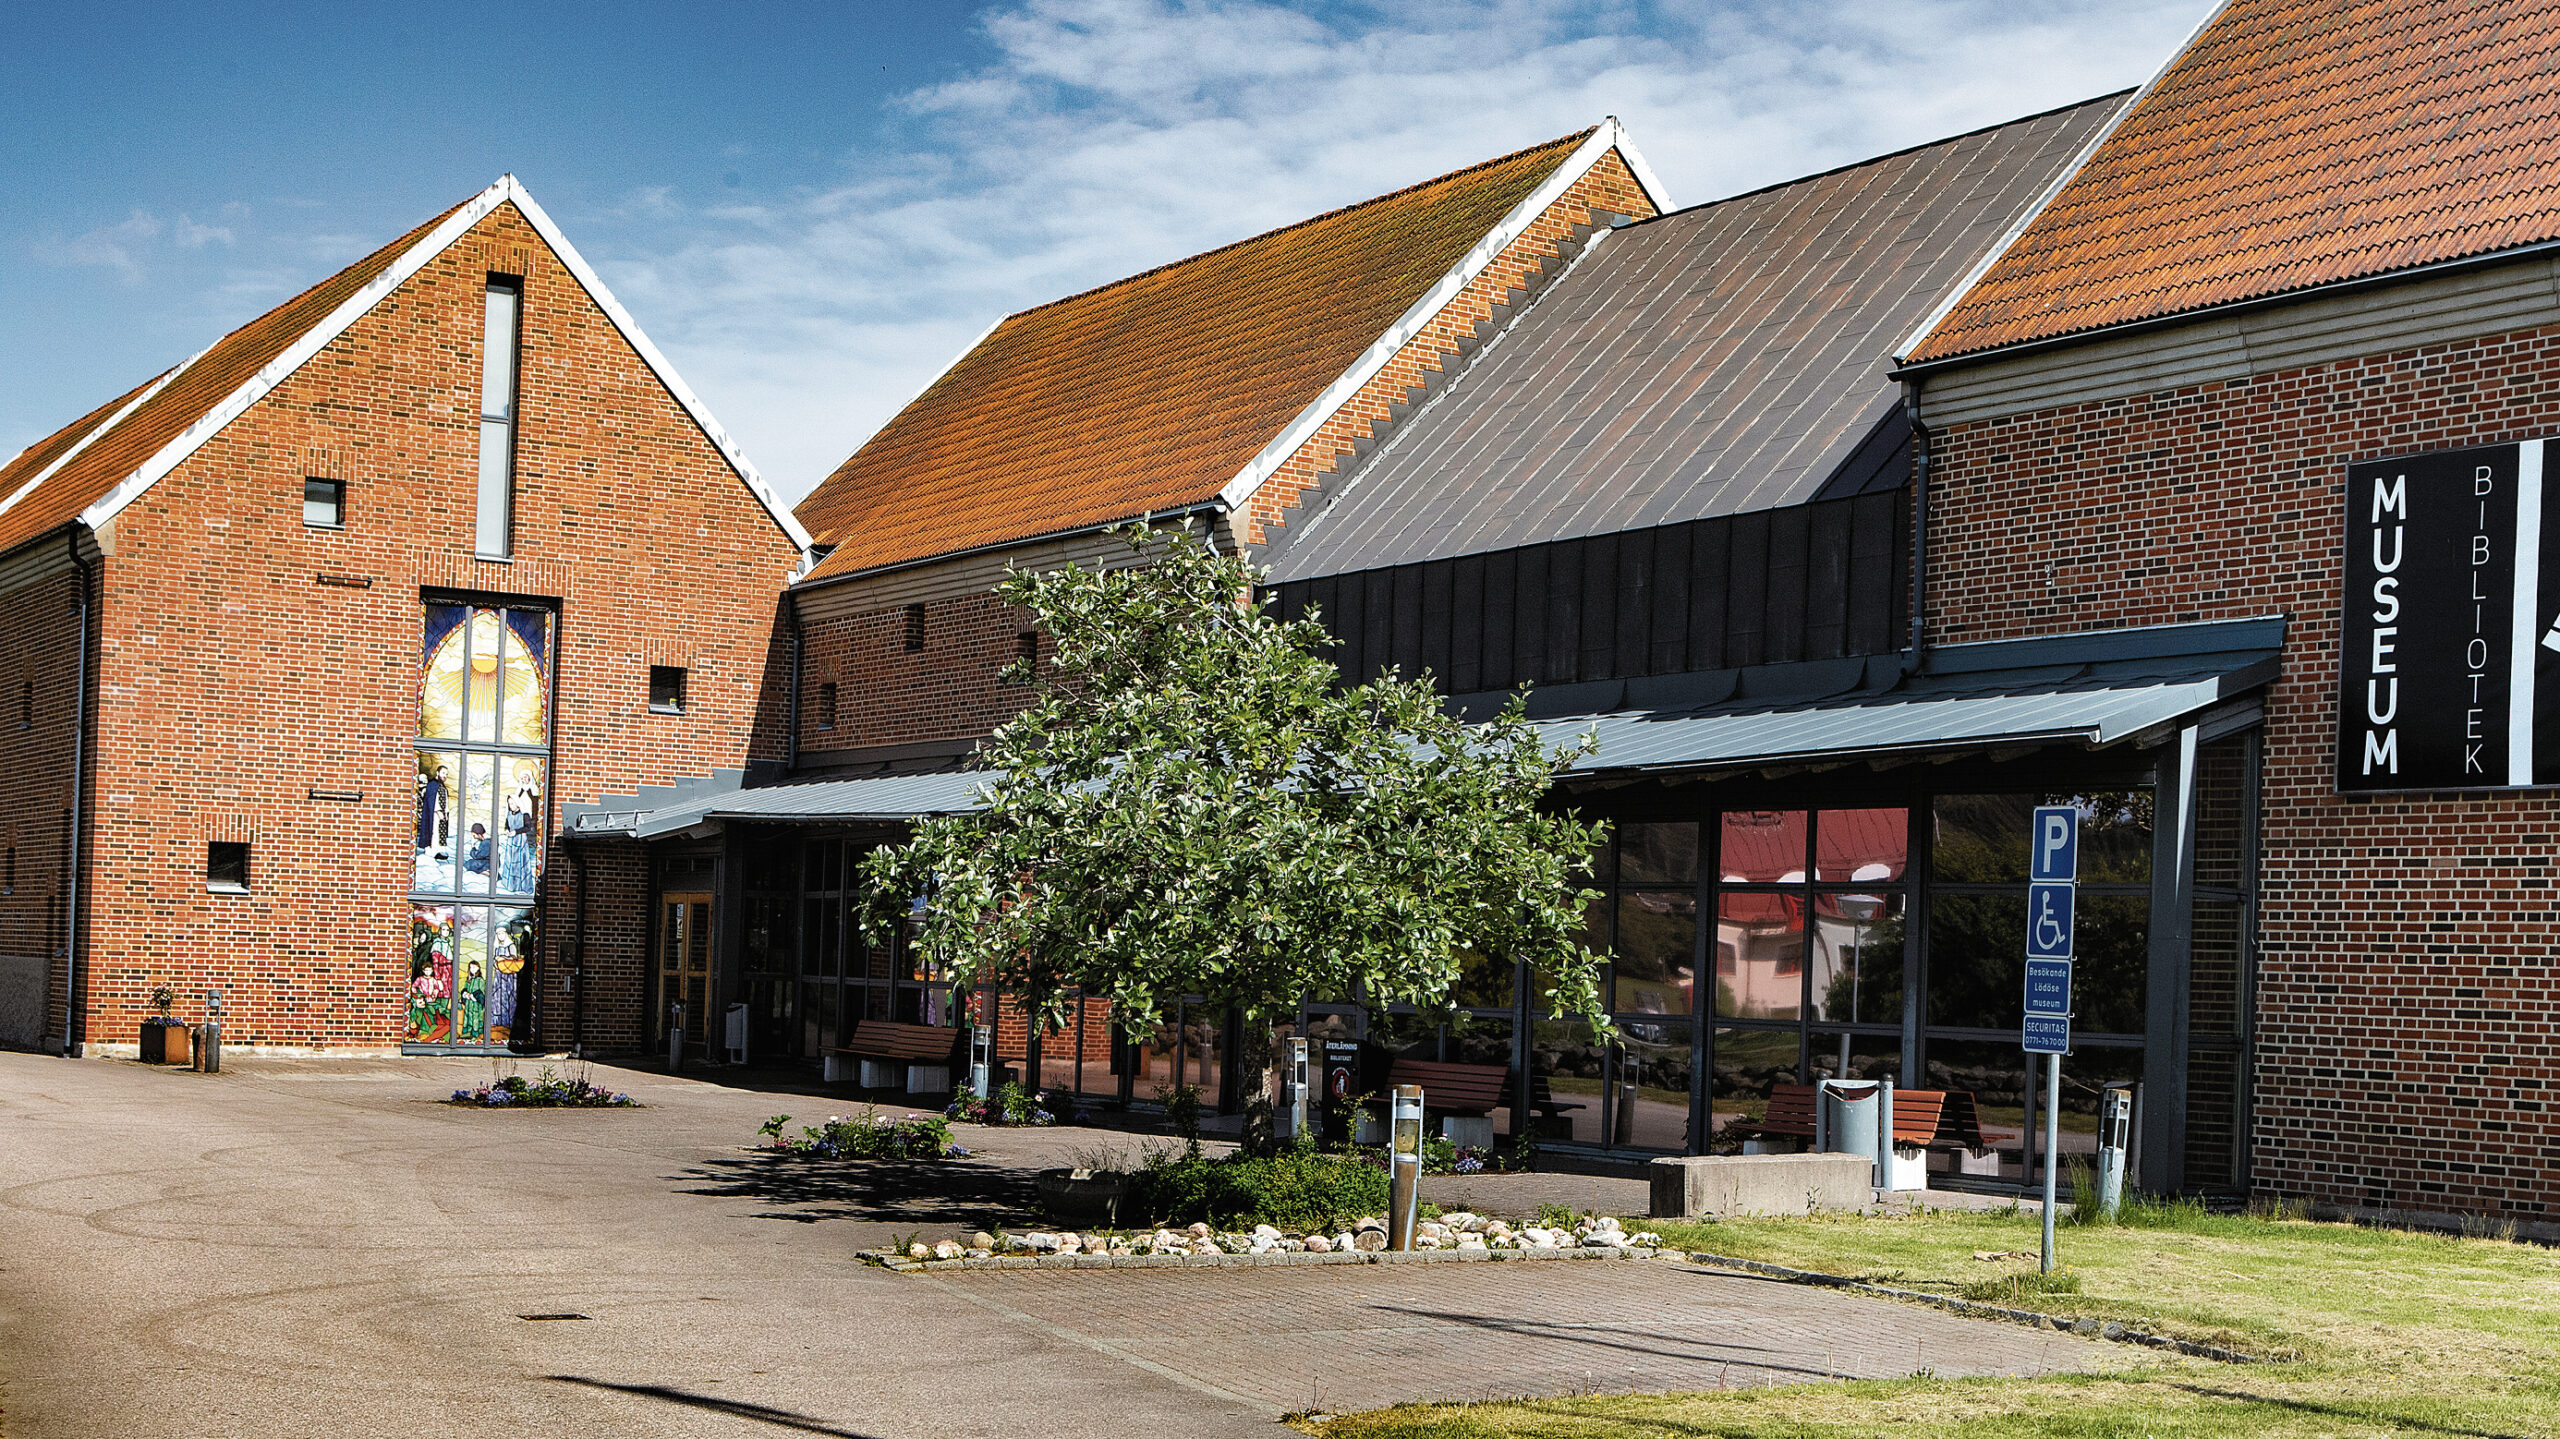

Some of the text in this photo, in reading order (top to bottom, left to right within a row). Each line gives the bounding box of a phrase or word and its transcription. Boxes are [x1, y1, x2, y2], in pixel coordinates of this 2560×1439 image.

[2363, 475, 2406, 775] MUSEUM
[2466, 466, 2492, 774] BIBLIOTEK
[2042, 815, 2068, 873] P
[2029, 967, 2067, 977] Besökande
[2034, 982, 2060, 992] Lödöse
[2032, 999, 2060, 1007] museum
[2026, 1022, 2065, 1033] SECURITAS
